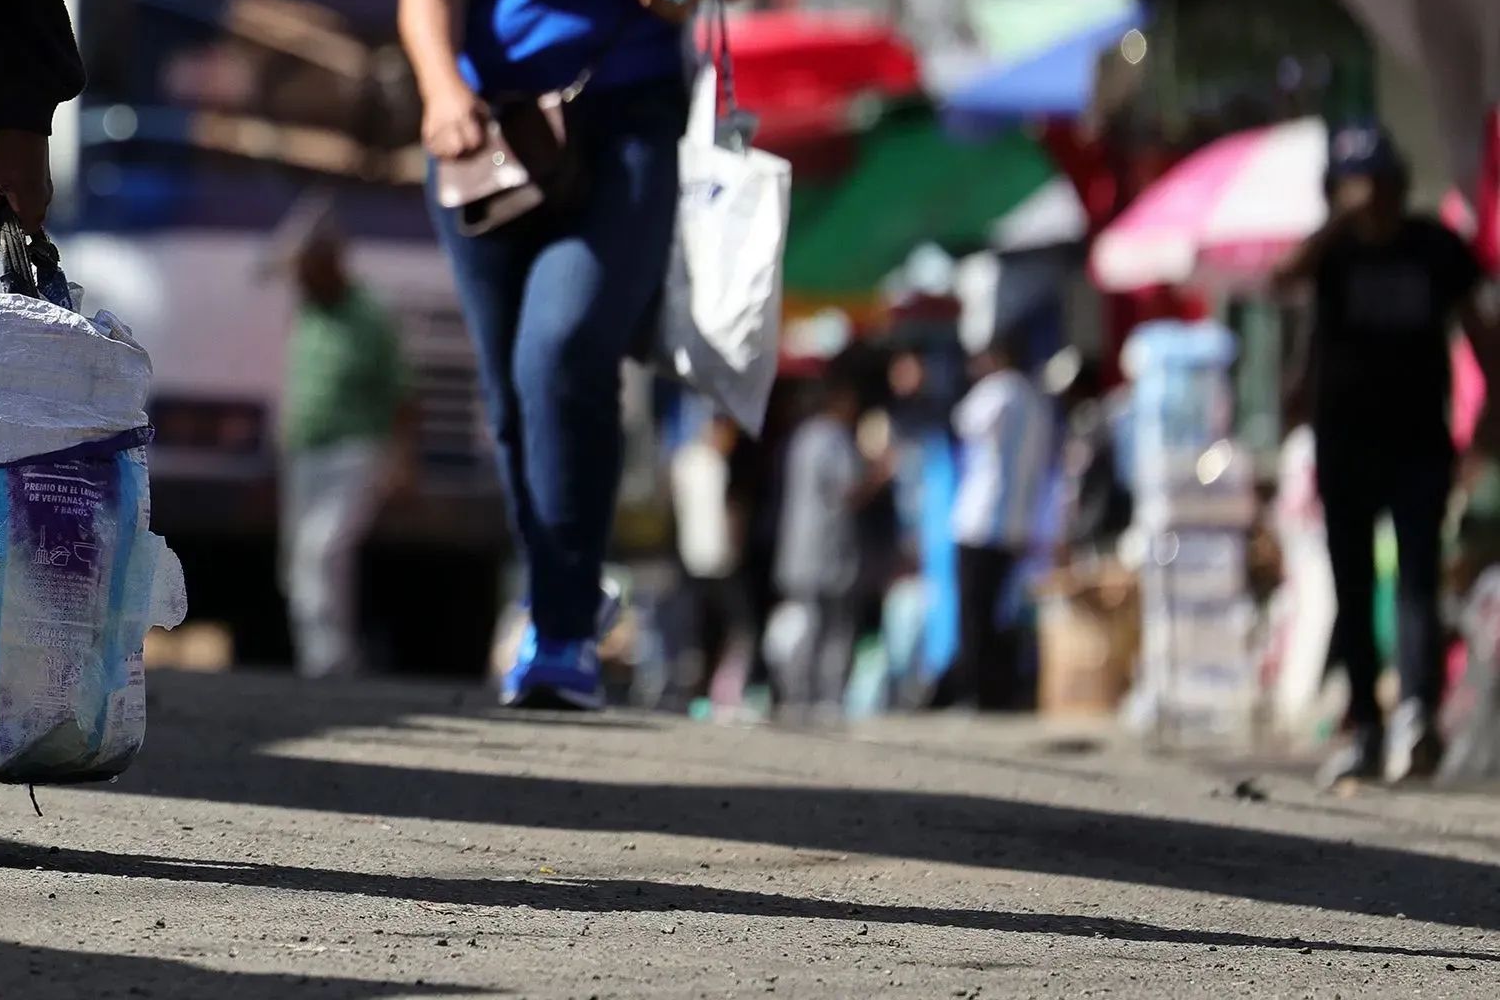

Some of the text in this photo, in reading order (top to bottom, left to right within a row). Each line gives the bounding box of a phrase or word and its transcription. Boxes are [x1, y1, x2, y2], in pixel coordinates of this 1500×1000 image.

[24, 482, 56, 492] PREMIO
[58, 484, 68, 493] EN
[70, 486, 79, 495] EL
[28, 493, 40, 503] DE
[41, 494, 85, 507] VENTANAS,
